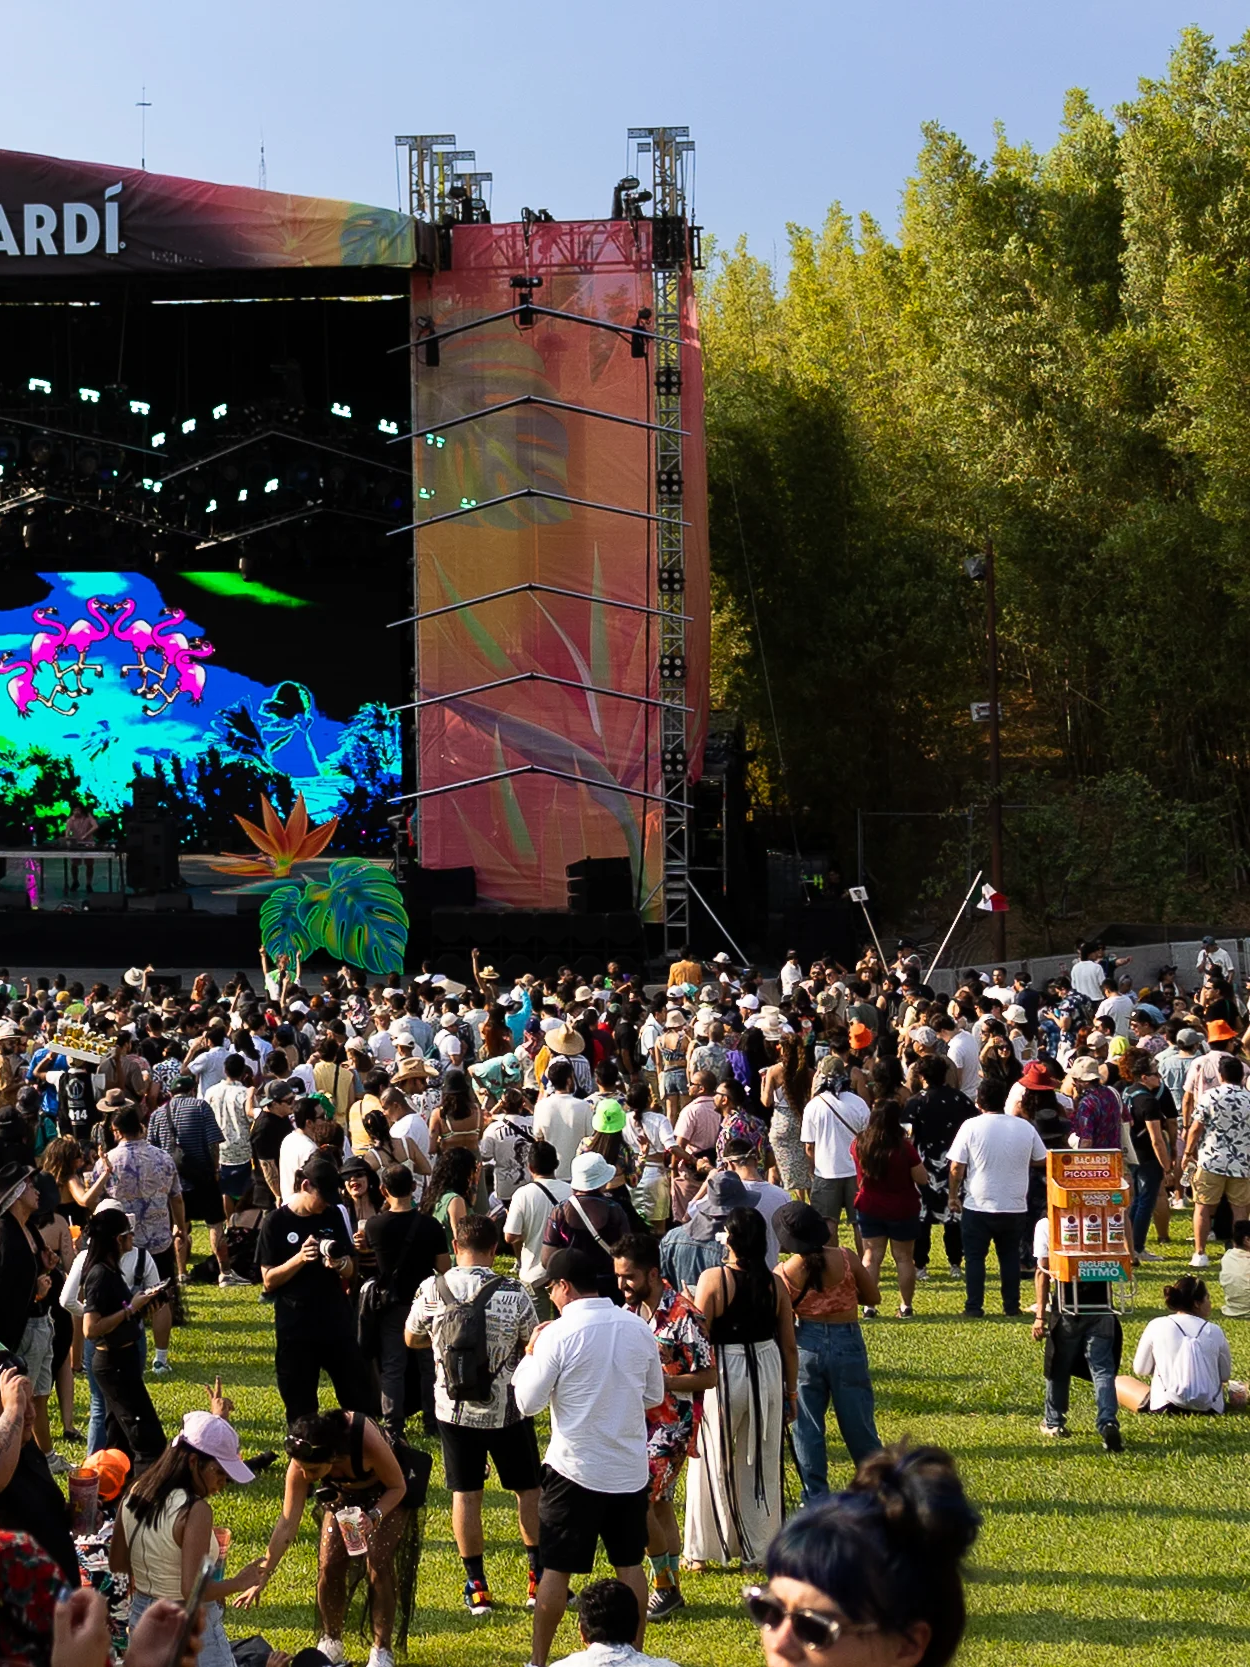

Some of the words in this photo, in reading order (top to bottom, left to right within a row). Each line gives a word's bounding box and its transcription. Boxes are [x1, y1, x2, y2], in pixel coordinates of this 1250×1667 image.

[1063, 1170, 1110, 1178] PICOSITO
[1078, 1260, 1106, 1268] SIGUE
[1108, 1260, 1120, 1268] TU
[1078, 1268, 1120, 1277] RITMO
